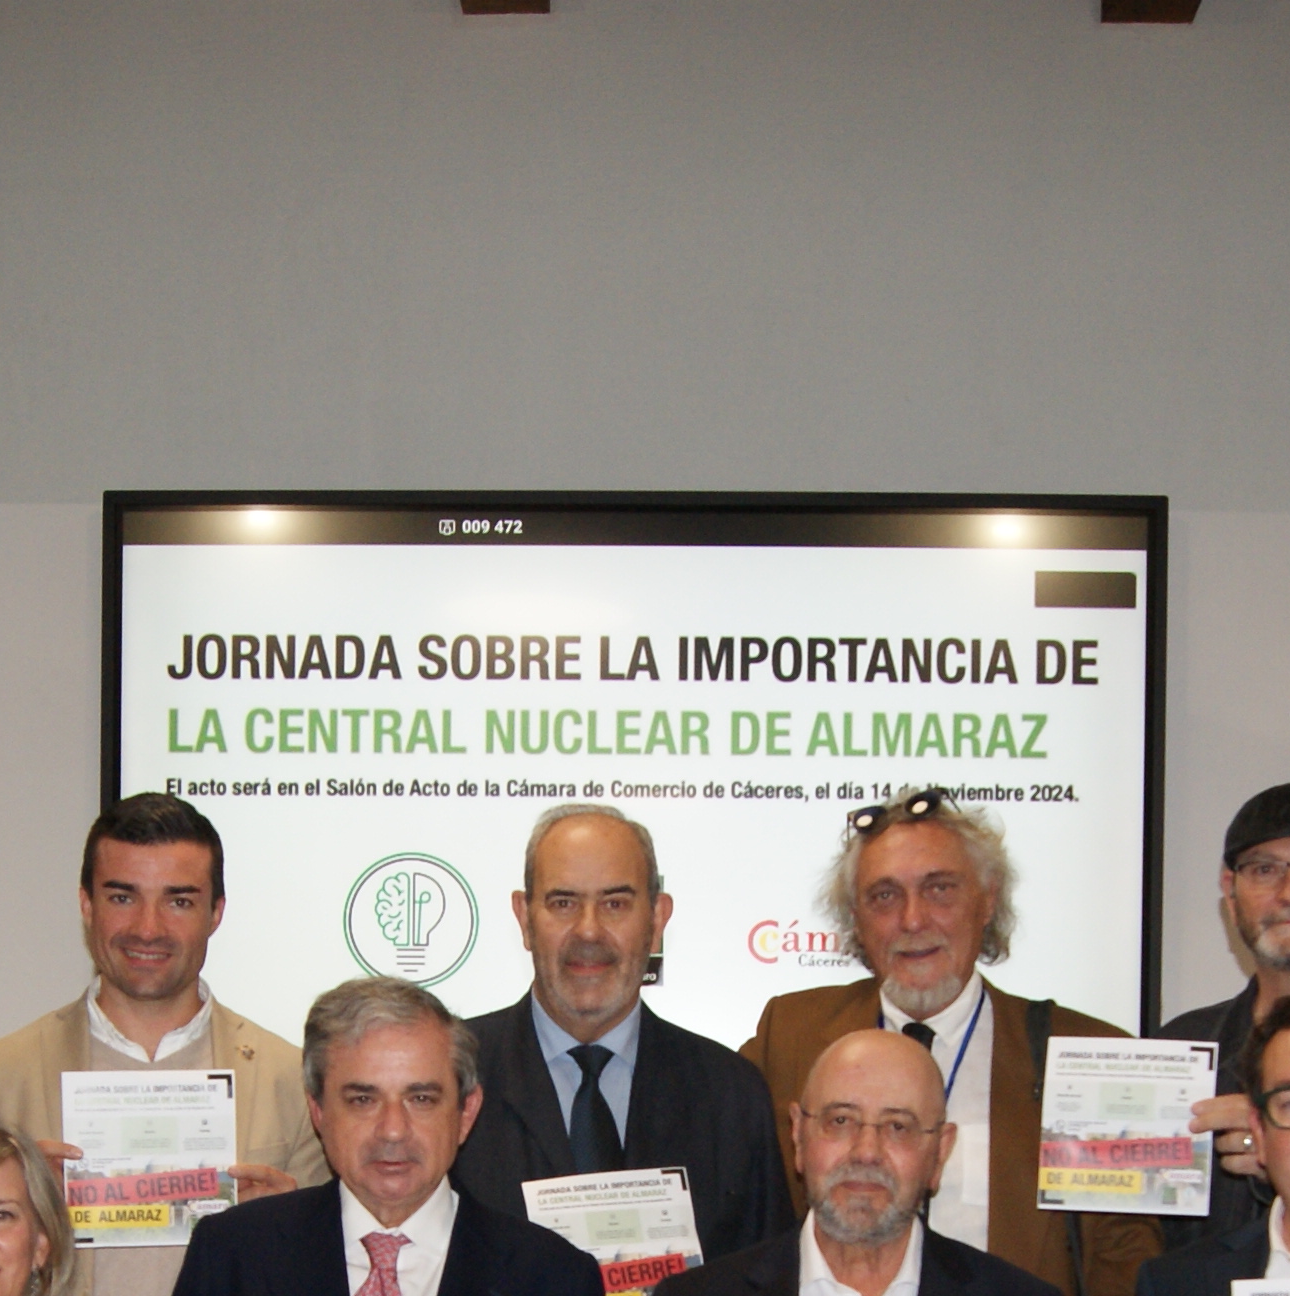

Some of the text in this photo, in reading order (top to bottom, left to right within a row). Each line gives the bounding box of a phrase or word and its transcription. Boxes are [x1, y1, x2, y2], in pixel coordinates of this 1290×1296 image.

[462, 520, 522, 533] 009 472
[167, 634, 1099, 685] JORNADA SOBRE LA IMPORTANCIA DE
[168, 709, 1047, 759] LA CENTRAL NUCLEAR DE ALMARAZ
[166, 779, 181, 795] El
[188, 781, 226, 797] acto
[232, 778, 271, 796] será
[278, 783, 298, 796] en
[305, 780, 320, 796] el
[327, 778, 376, 797] Salón
[383, 780, 404, 797] de
[410, 780, 450, 797] Acto
[456, 780, 478, 797] de
[484, 780, 500, 797] la
[506, 778, 575, 797] Cámara
[582, 781, 604, 797] de
[611, 780, 696, 799] Comercio
[703, 782, 724, 799] de
[731, 780, 809, 802] Cáceres,
[816, 783, 830, 799] el
[837, 781, 864, 800] día
[871, 783, 890, 800] 14
[1030, 786, 1079, 802] 2024.
[69, 1172, 216, 1206] NO AL CIERRE!
[75, 1210, 162, 1223] DE ALMARAZ
